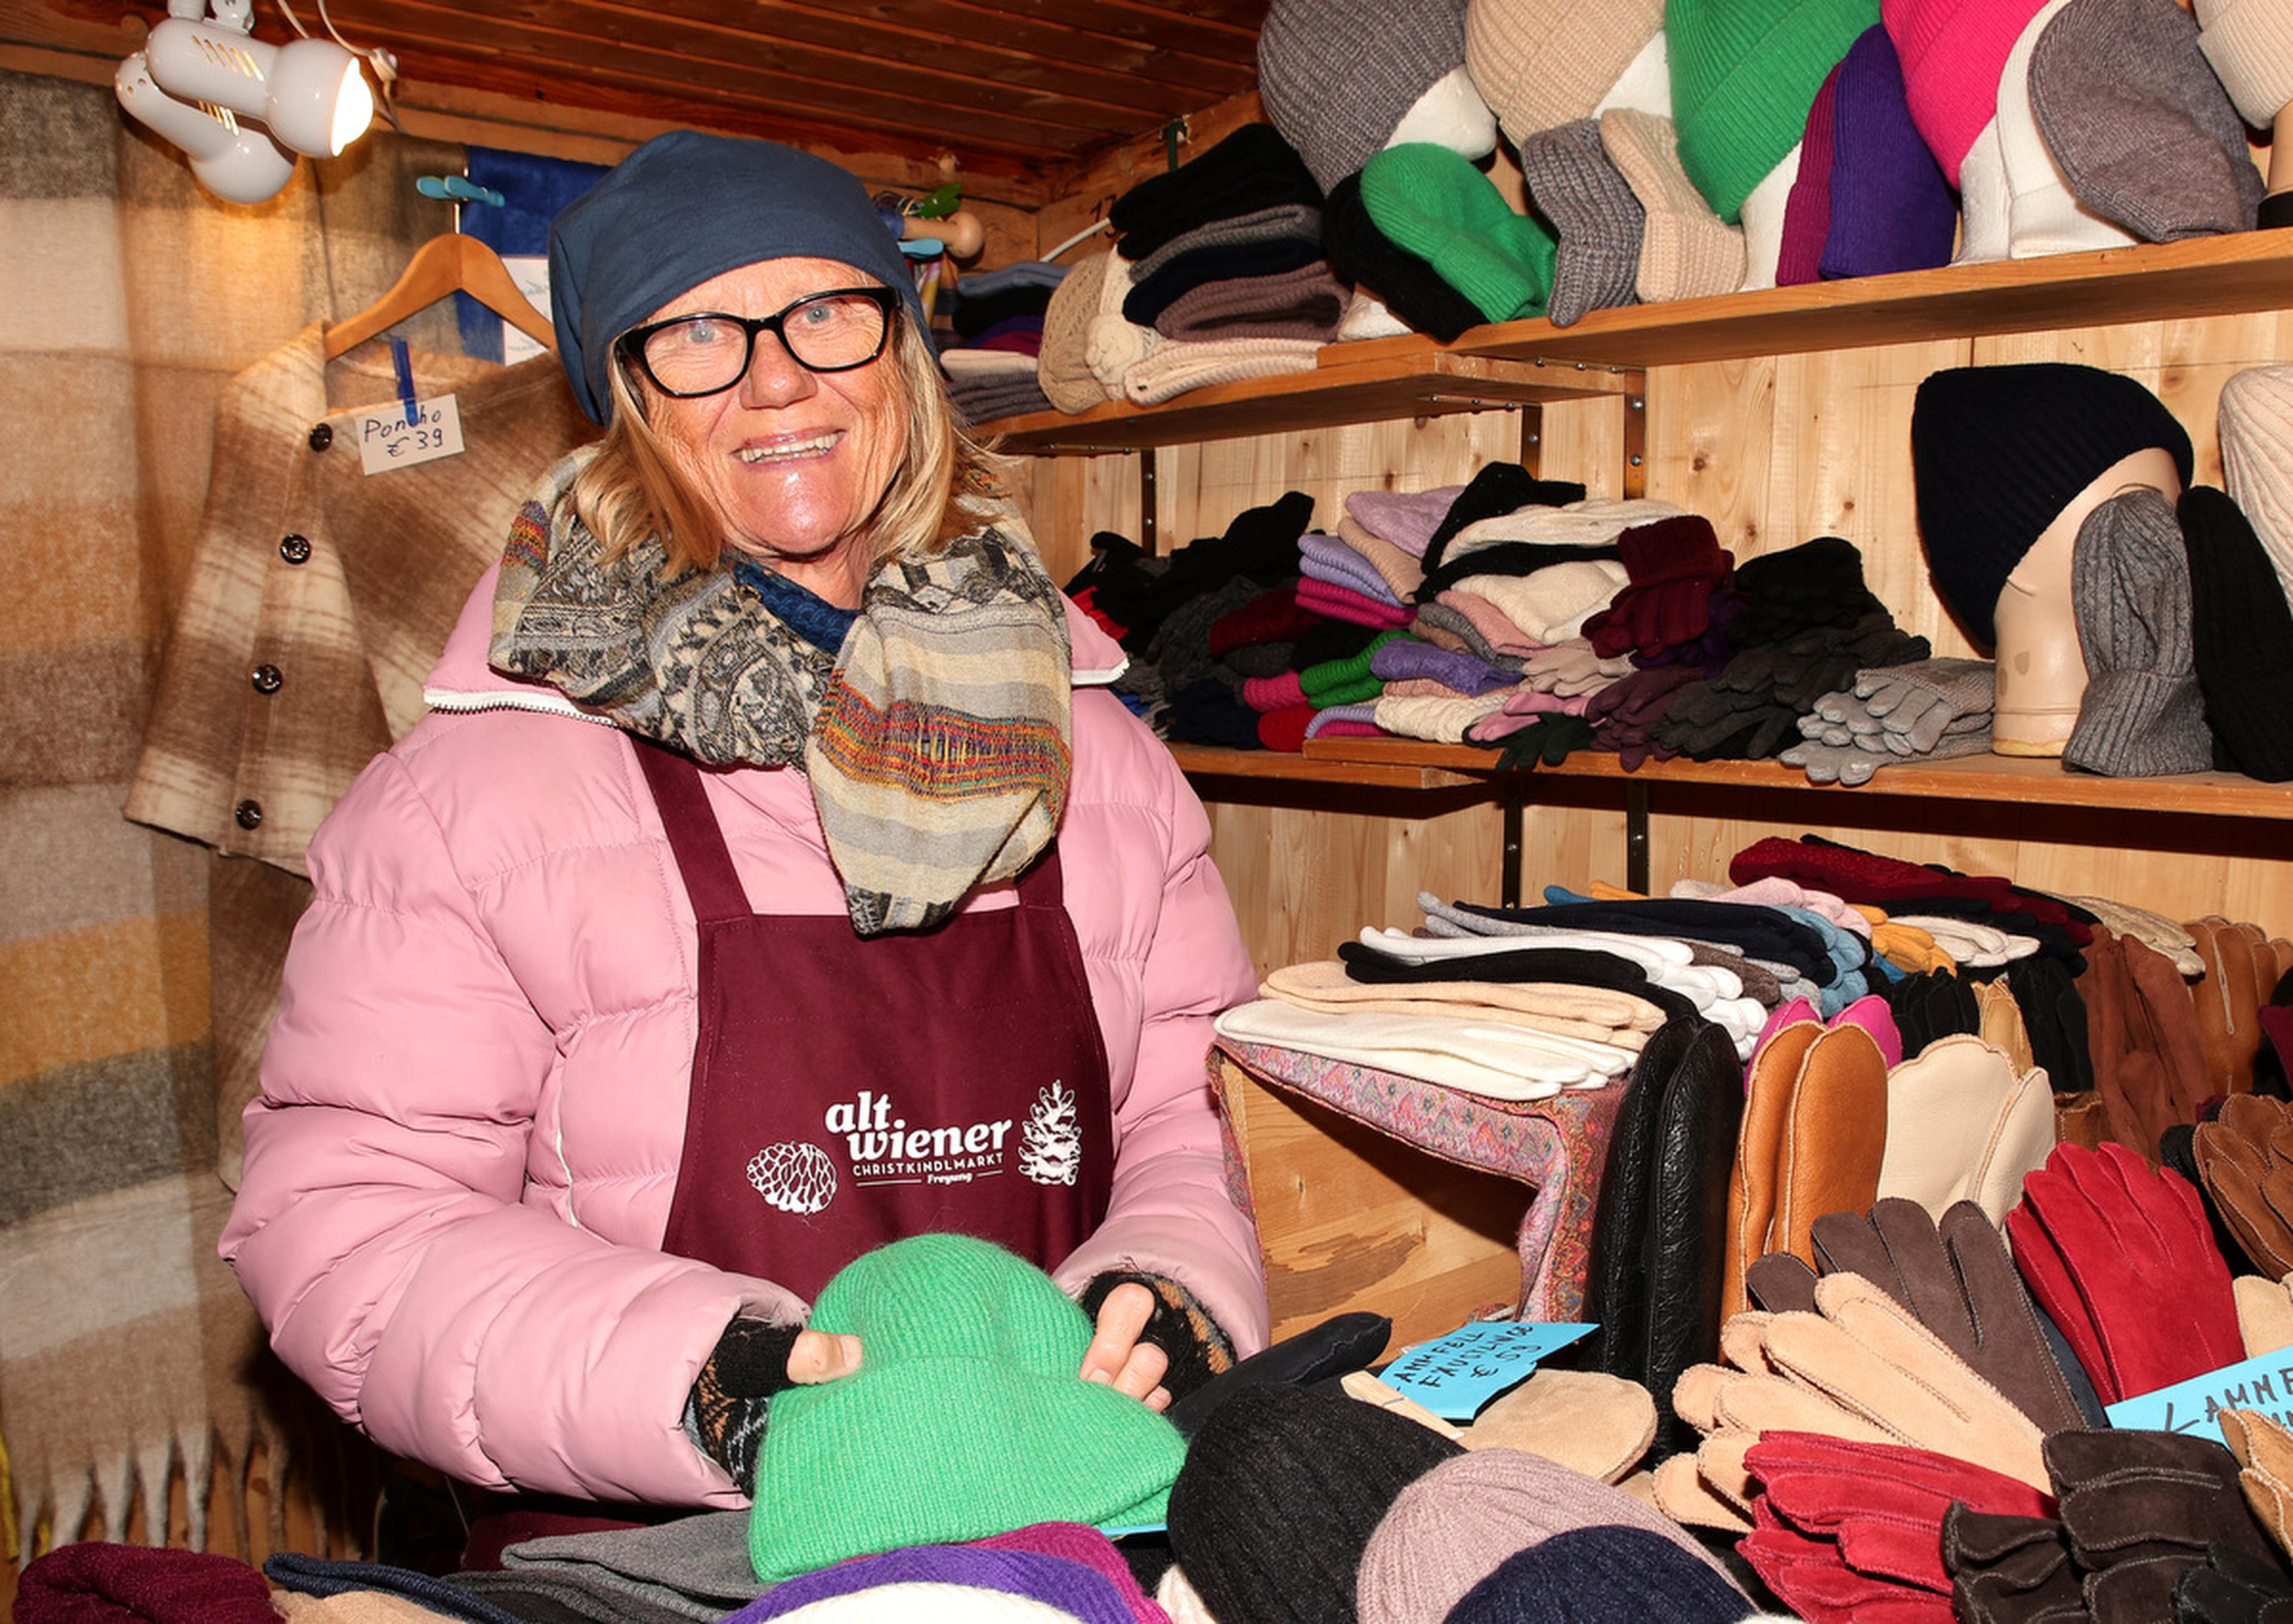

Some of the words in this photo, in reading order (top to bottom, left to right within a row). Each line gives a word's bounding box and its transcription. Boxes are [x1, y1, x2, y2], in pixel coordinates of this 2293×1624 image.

[365, 405, 442, 442] Ponho
[416, 428, 442, 450] 39
[825, 1091, 891, 1133] alt
[846, 1119, 1013, 1161] wiener
[853, 1152, 1004, 1176] CHRISTKINDLMARKT
